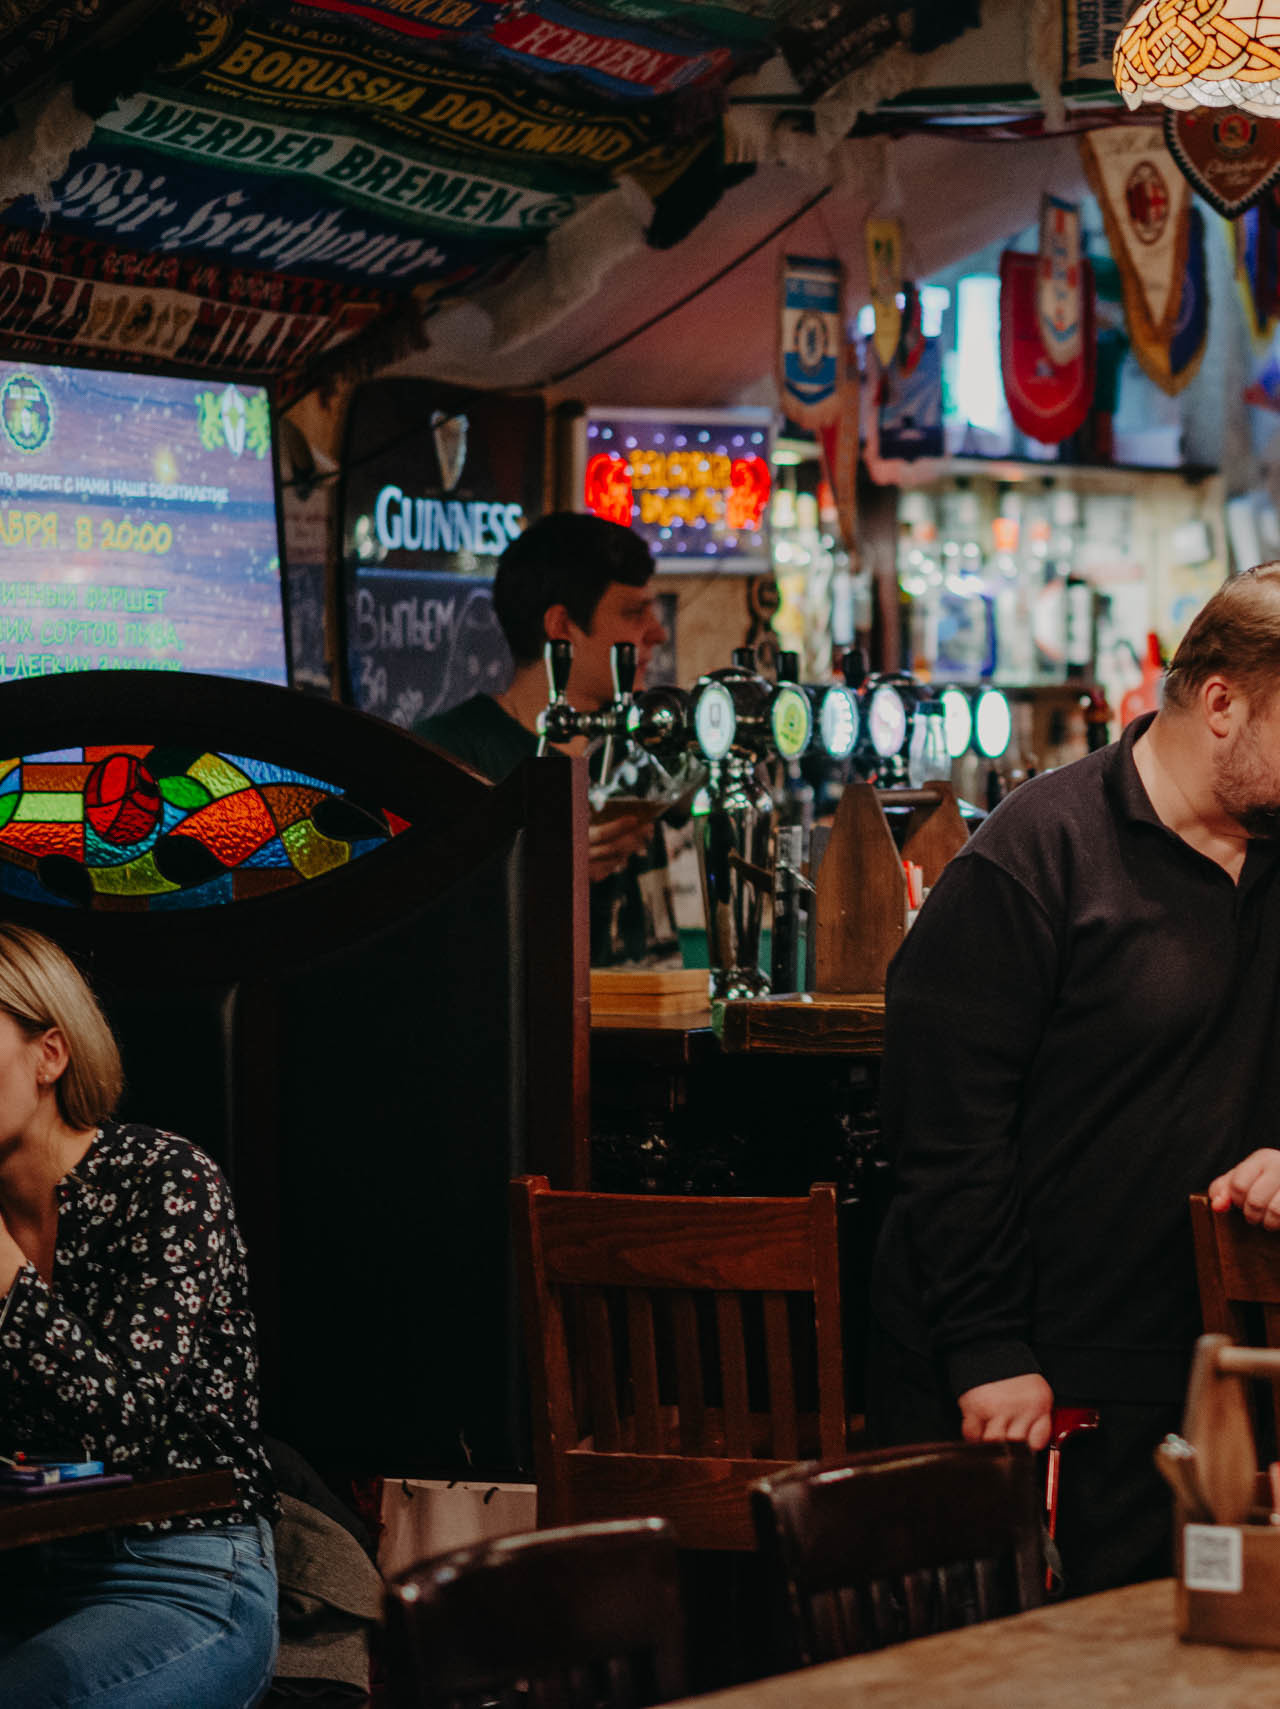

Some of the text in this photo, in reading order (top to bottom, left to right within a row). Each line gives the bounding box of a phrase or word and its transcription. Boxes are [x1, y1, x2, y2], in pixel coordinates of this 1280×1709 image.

[511, 20, 571, 54] FC
[547, 33, 663, 82] BAYERN
[217, 39, 428, 113] BORUSSIA
[420, 92, 633, 163] DORTMUND
[123, 100, 325, 170] WERDER
[325, 138, 522, 226] BREMEN
[16, 473, 62, 492] ВМЕСТЕ
[75, 476, 110, 495] НАМИ
[101, 518, 172, 554] 20:00
[375, 483, 522, 557] GUINNESS
[85, 584, 168, 614] ФУРШЕТ
[40, 618, 120, 648] СОРТОВ
